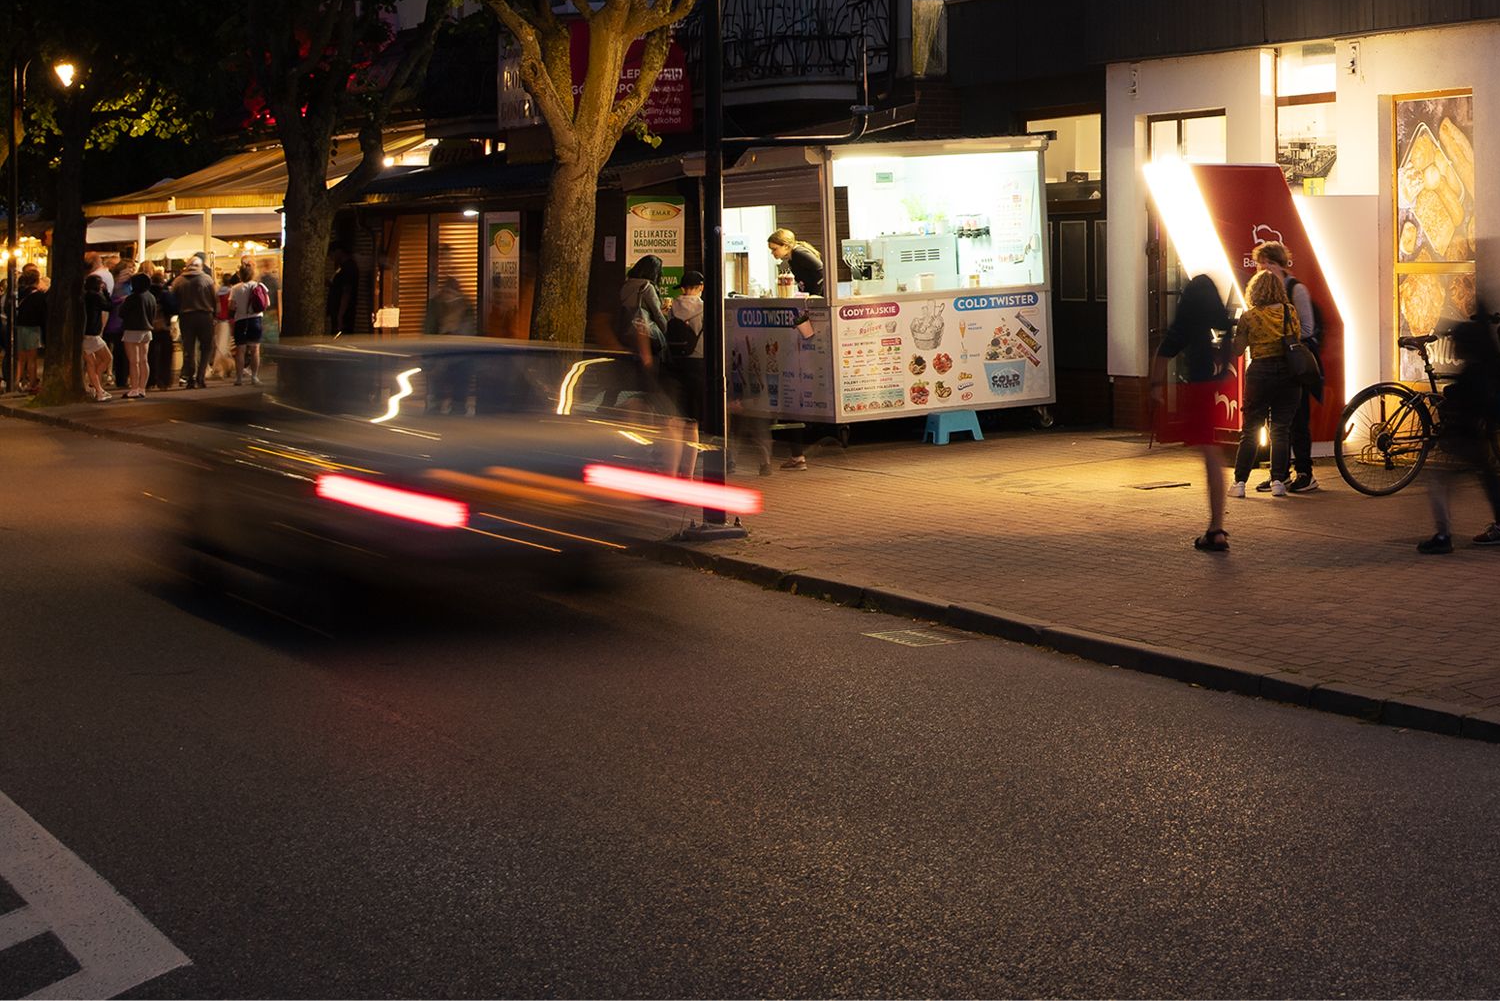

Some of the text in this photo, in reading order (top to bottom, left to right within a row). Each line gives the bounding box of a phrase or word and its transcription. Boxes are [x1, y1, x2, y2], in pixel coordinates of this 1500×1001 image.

[633, 230, 678, 238] DELIKATESY
[633, 239, 678, 247] NADMORSKIE
[957, 294, 1034, 309] COLD TWISTER
[742, 309, 795, 326] COLD TWISTER
[842, 305, 897, 318] LODY TAJSKIE
[991, 373, 1020, 384] COLD
